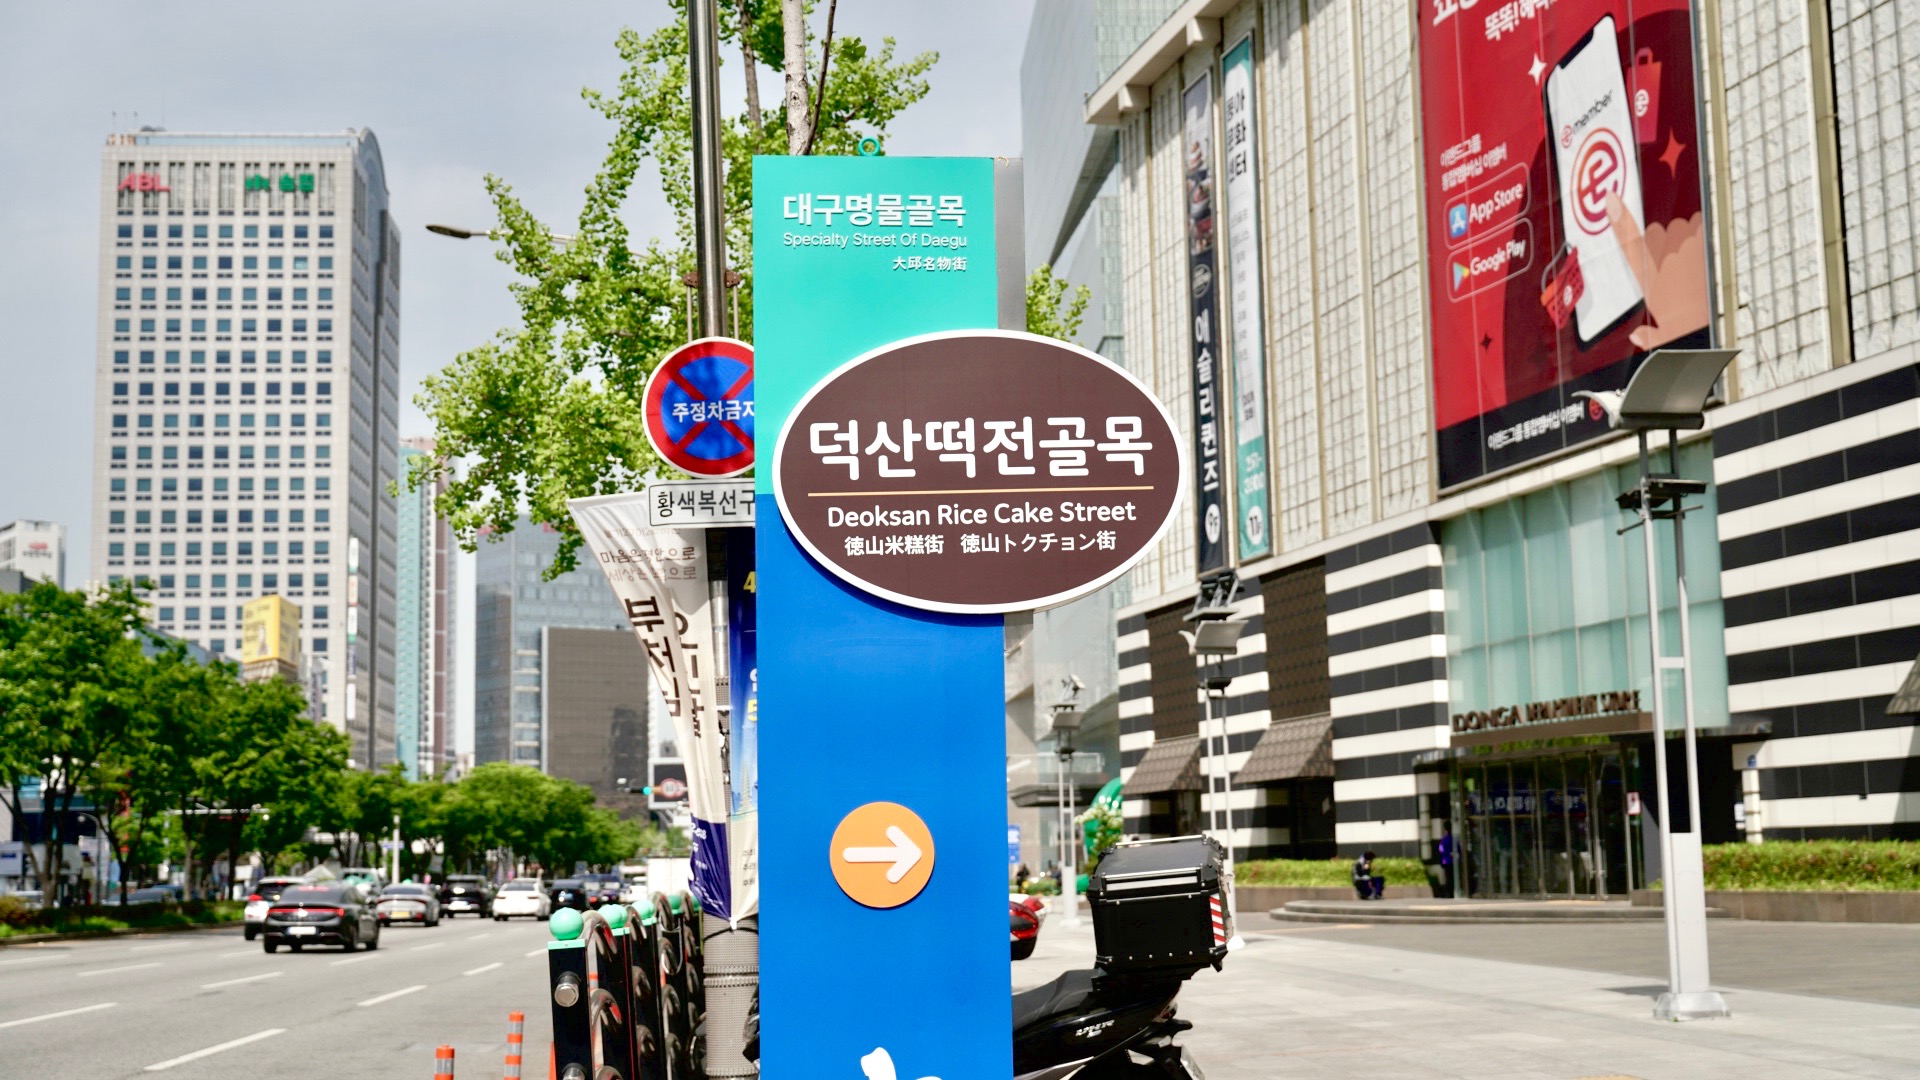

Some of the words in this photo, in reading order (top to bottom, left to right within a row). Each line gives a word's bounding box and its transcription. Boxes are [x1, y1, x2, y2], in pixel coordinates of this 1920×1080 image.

[1572, 89, 1613, 134] member
[784, 193, 967, 227] 대구명물골목
[1469, 203, 1495, 224] App
[1494, 183, 1523, 212] Store
[783, 232, 849, 249] Specialty
[853, 233, 897, 247] Street
[900, 233, 918, 247] Of
[921, 233, 967, 250] Daegu
[1470, 247, 1506, 276] Google
[1506, 239, 1527, 260] Play
[892, 256, 967, 271] 大邱名物街
[1195, 308, 1220, 492] 애슐리퀸즈
[809, 415, 1153, 481] 덕산떡전골목
[827, 505, 930, 527] Deoksan
[937, 503, 988, 525] Rice
[994, 502, 1053, 523] Cake
[1060, 501, 1137, 522] Street
[1453, 704, 1523, 733] DONGA
